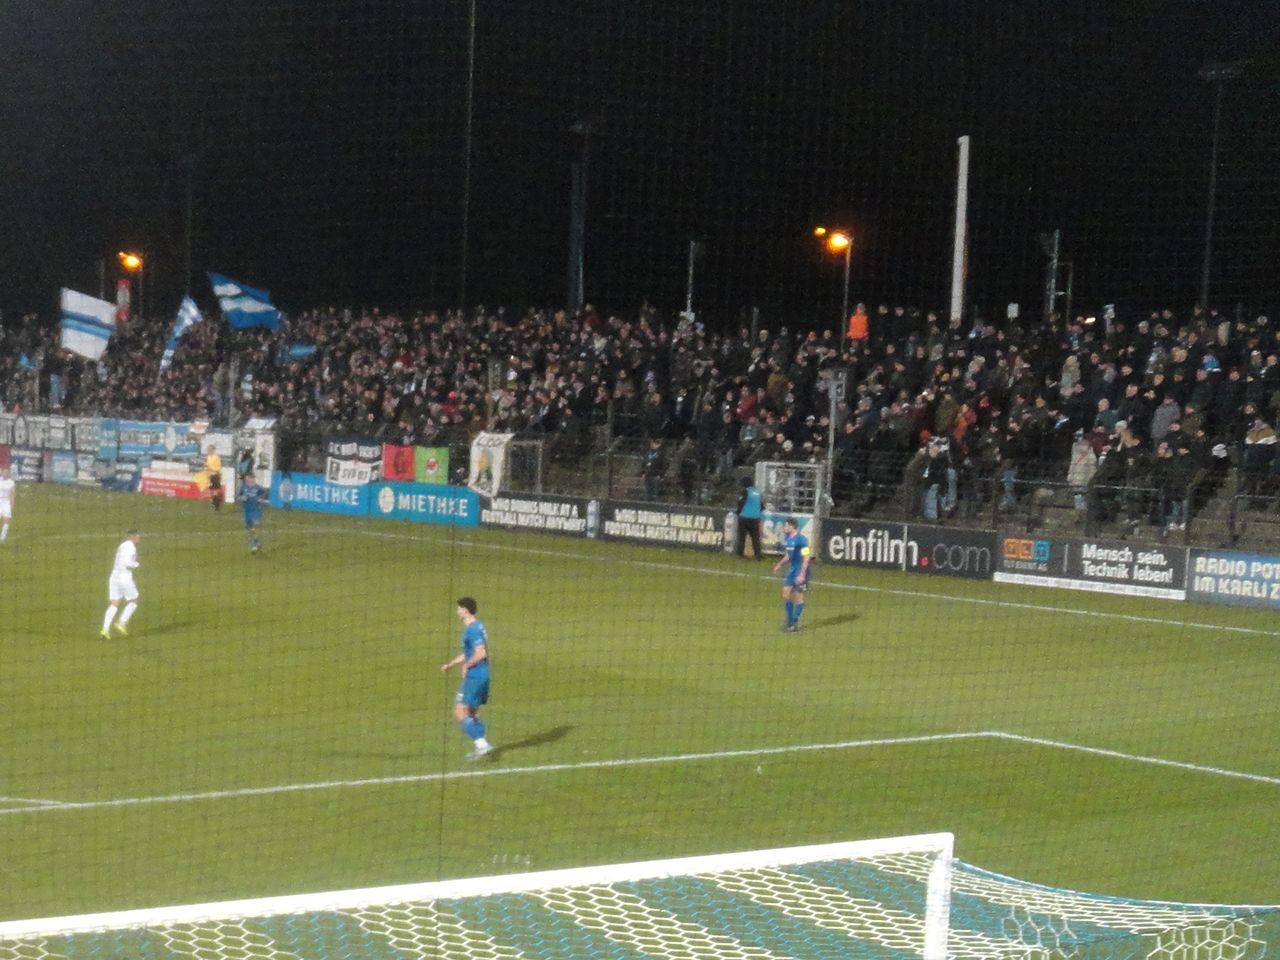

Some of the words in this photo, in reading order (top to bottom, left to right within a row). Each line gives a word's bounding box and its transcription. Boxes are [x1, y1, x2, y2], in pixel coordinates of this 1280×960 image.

[297, 484, 360, 506] MIETHKE
[399, 493, 469, 517] MIETHKE
[1082, 544, 1132, 562] Mensch
[1083, 561, 1129, 579] Technik
[1133, 565, 1173, 583] leben!
[1196, 557, 1247, 576] RADIO
